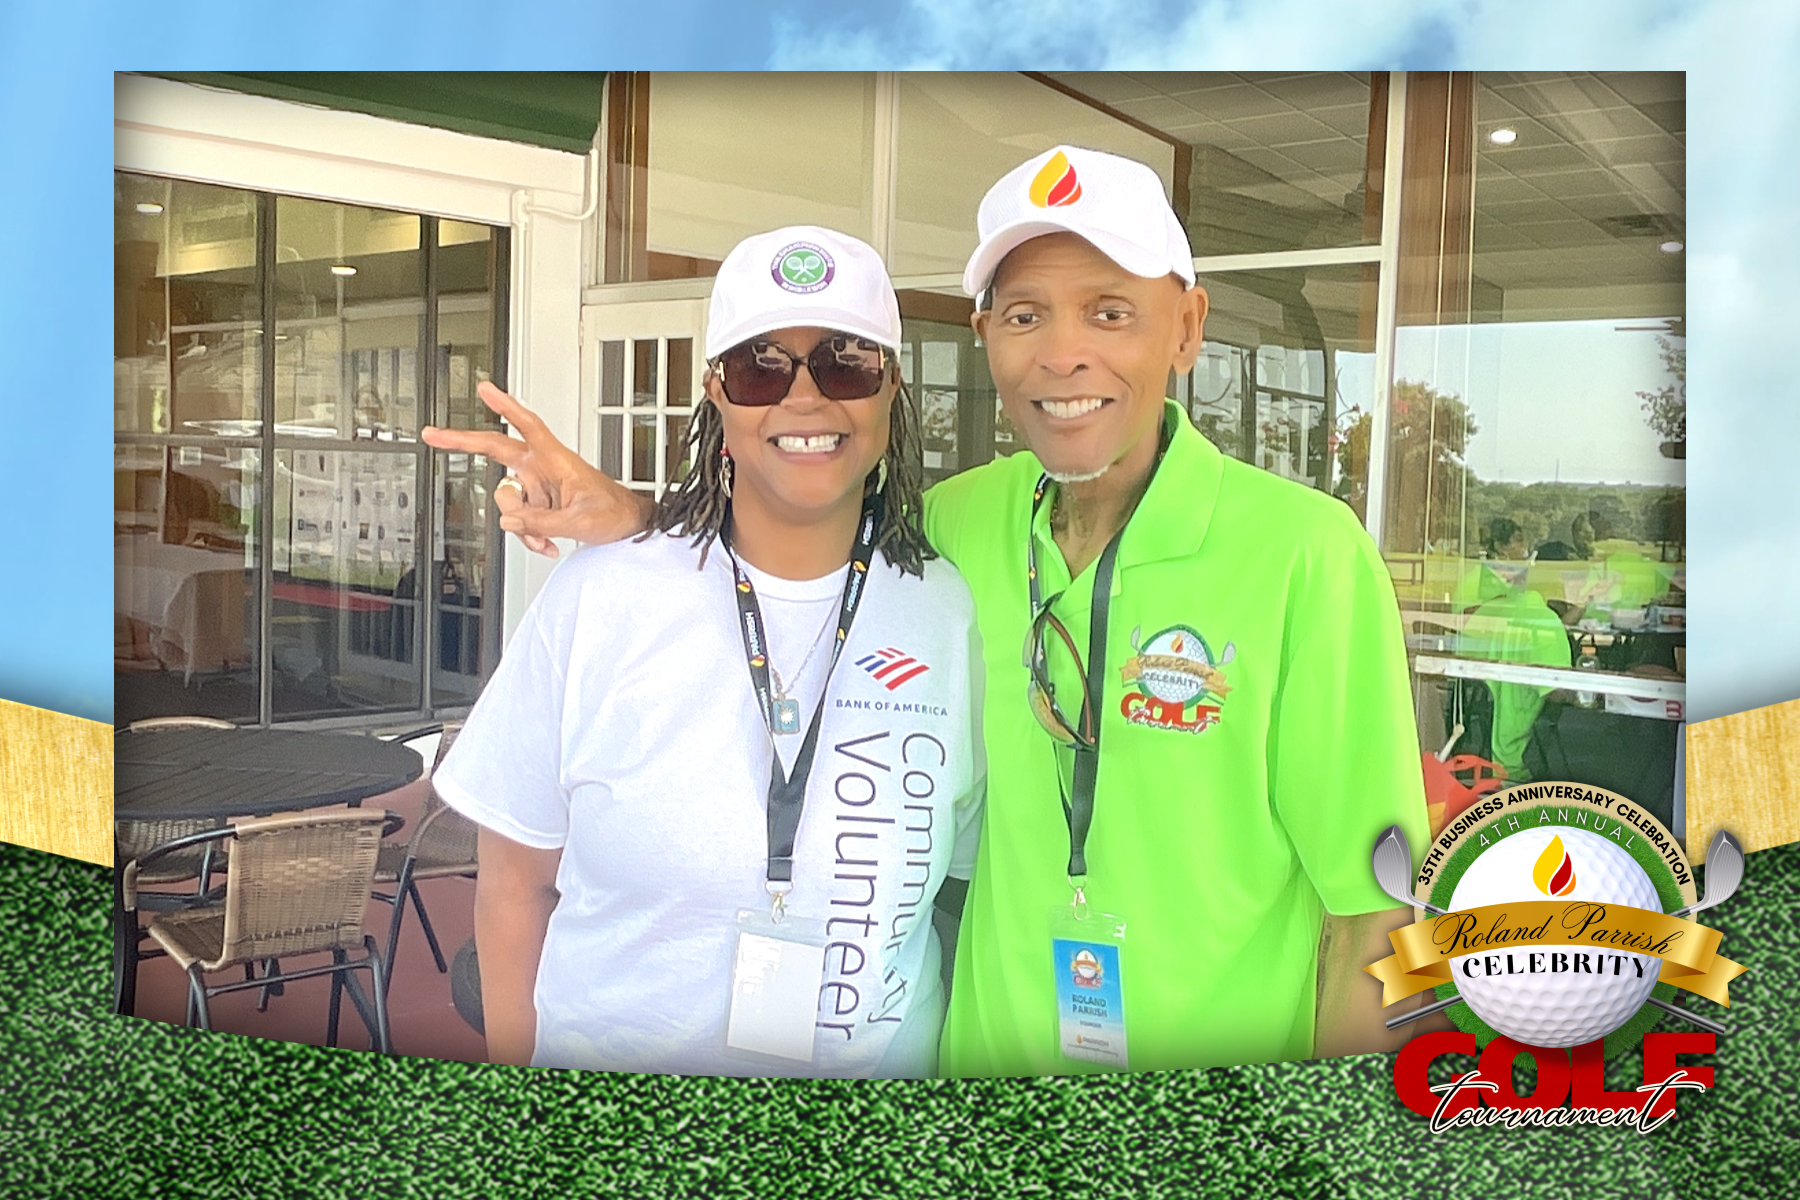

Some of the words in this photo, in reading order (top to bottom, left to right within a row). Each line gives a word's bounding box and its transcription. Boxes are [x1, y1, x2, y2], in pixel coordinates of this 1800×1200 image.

[745, 611, 760, 656] PARRISH
[1143, 671, 1201, 690] CELEBRITY
[836, 699, 871, 710] BANK
[874, 701, 891, 711] OF
[893, 703, 948, 716] AMERICA
[1120, 692, 1221, 730] GOLF
[815, 730, 896, 1041] Volunteer
[867, 732, 946, 1024] Community
